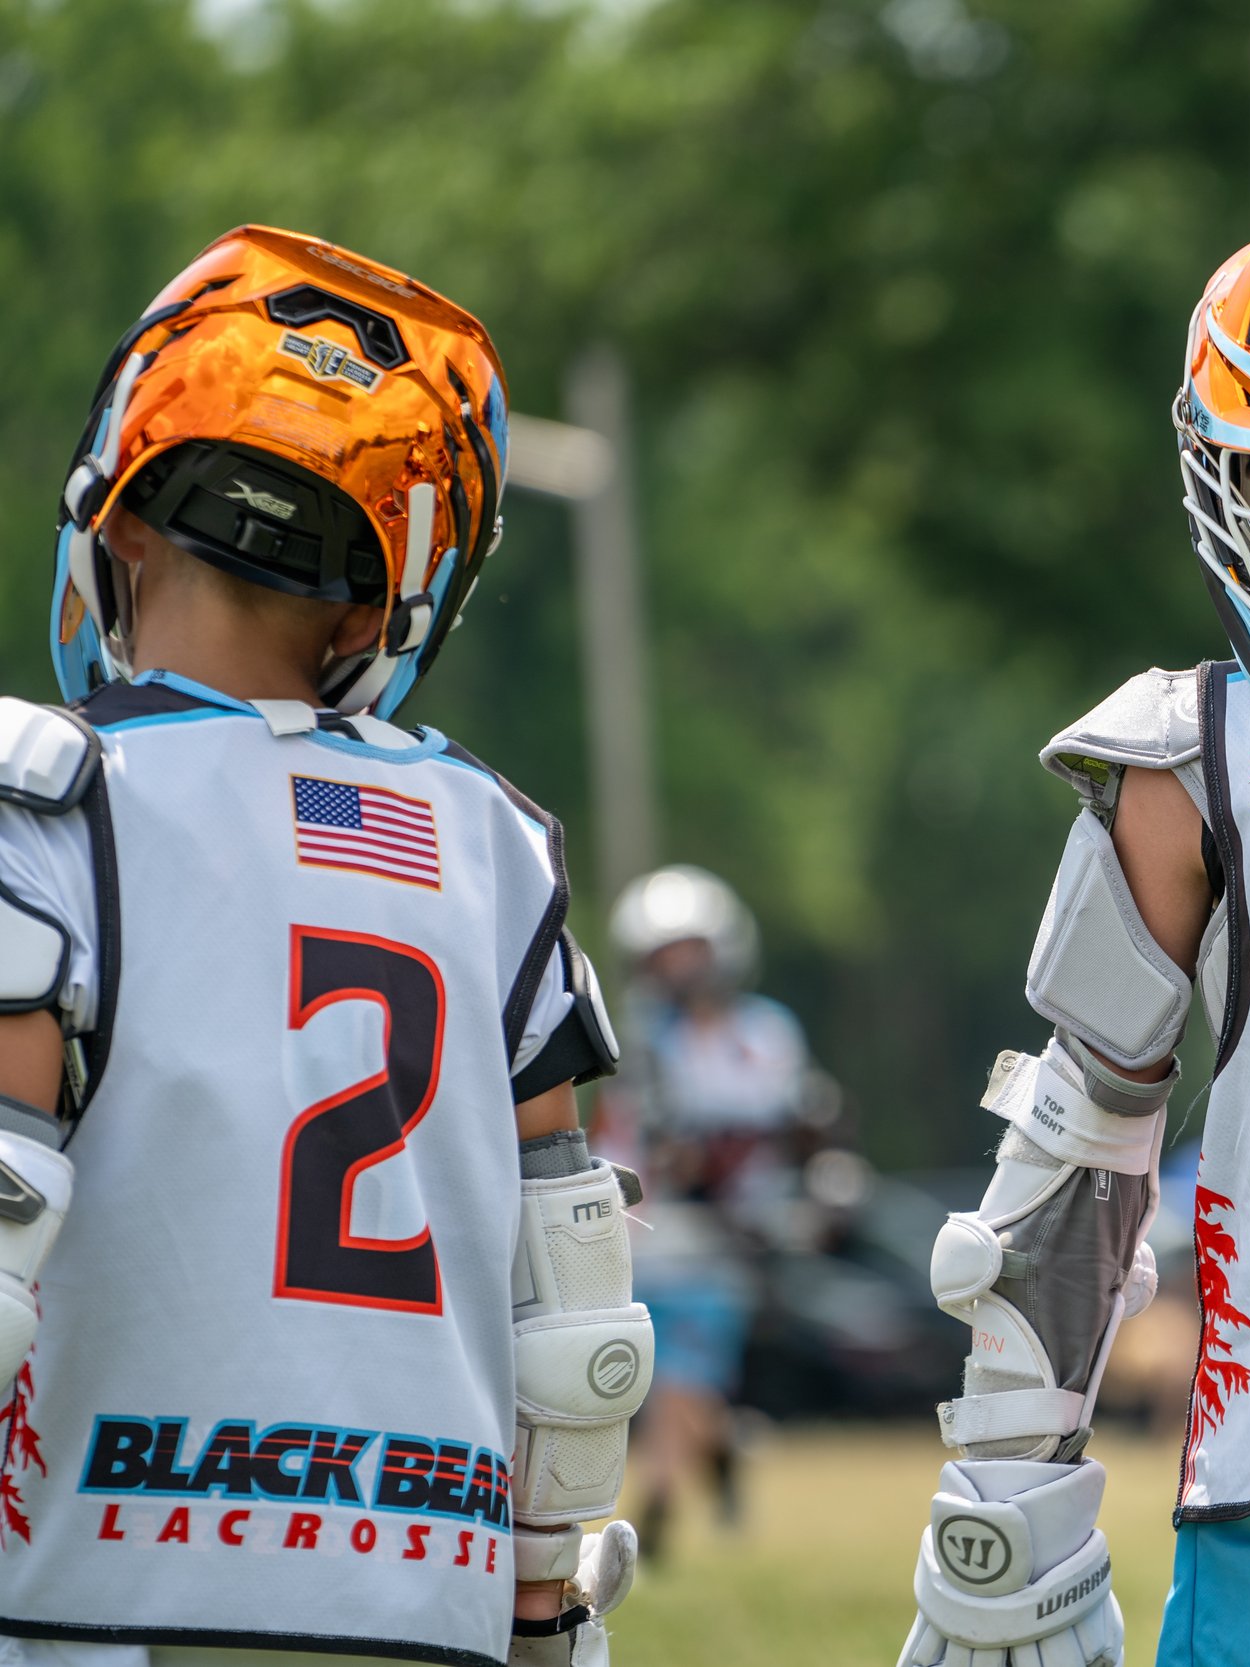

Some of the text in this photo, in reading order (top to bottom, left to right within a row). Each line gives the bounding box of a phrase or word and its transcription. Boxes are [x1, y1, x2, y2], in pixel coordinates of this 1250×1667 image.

[272, 923, 446, 1317] 2
[1031, 1106, 1066, 1136] RIGHT
[1043, 1095, 1065, 1116] TOP
[1097, 1170, 1107, 1189] DIUM
[78, 1414, 381, 1508] BLACK
[97, 1503, 497, 1574] LACROSSE
[1036, 1554, 1112, 1620] WARRI
